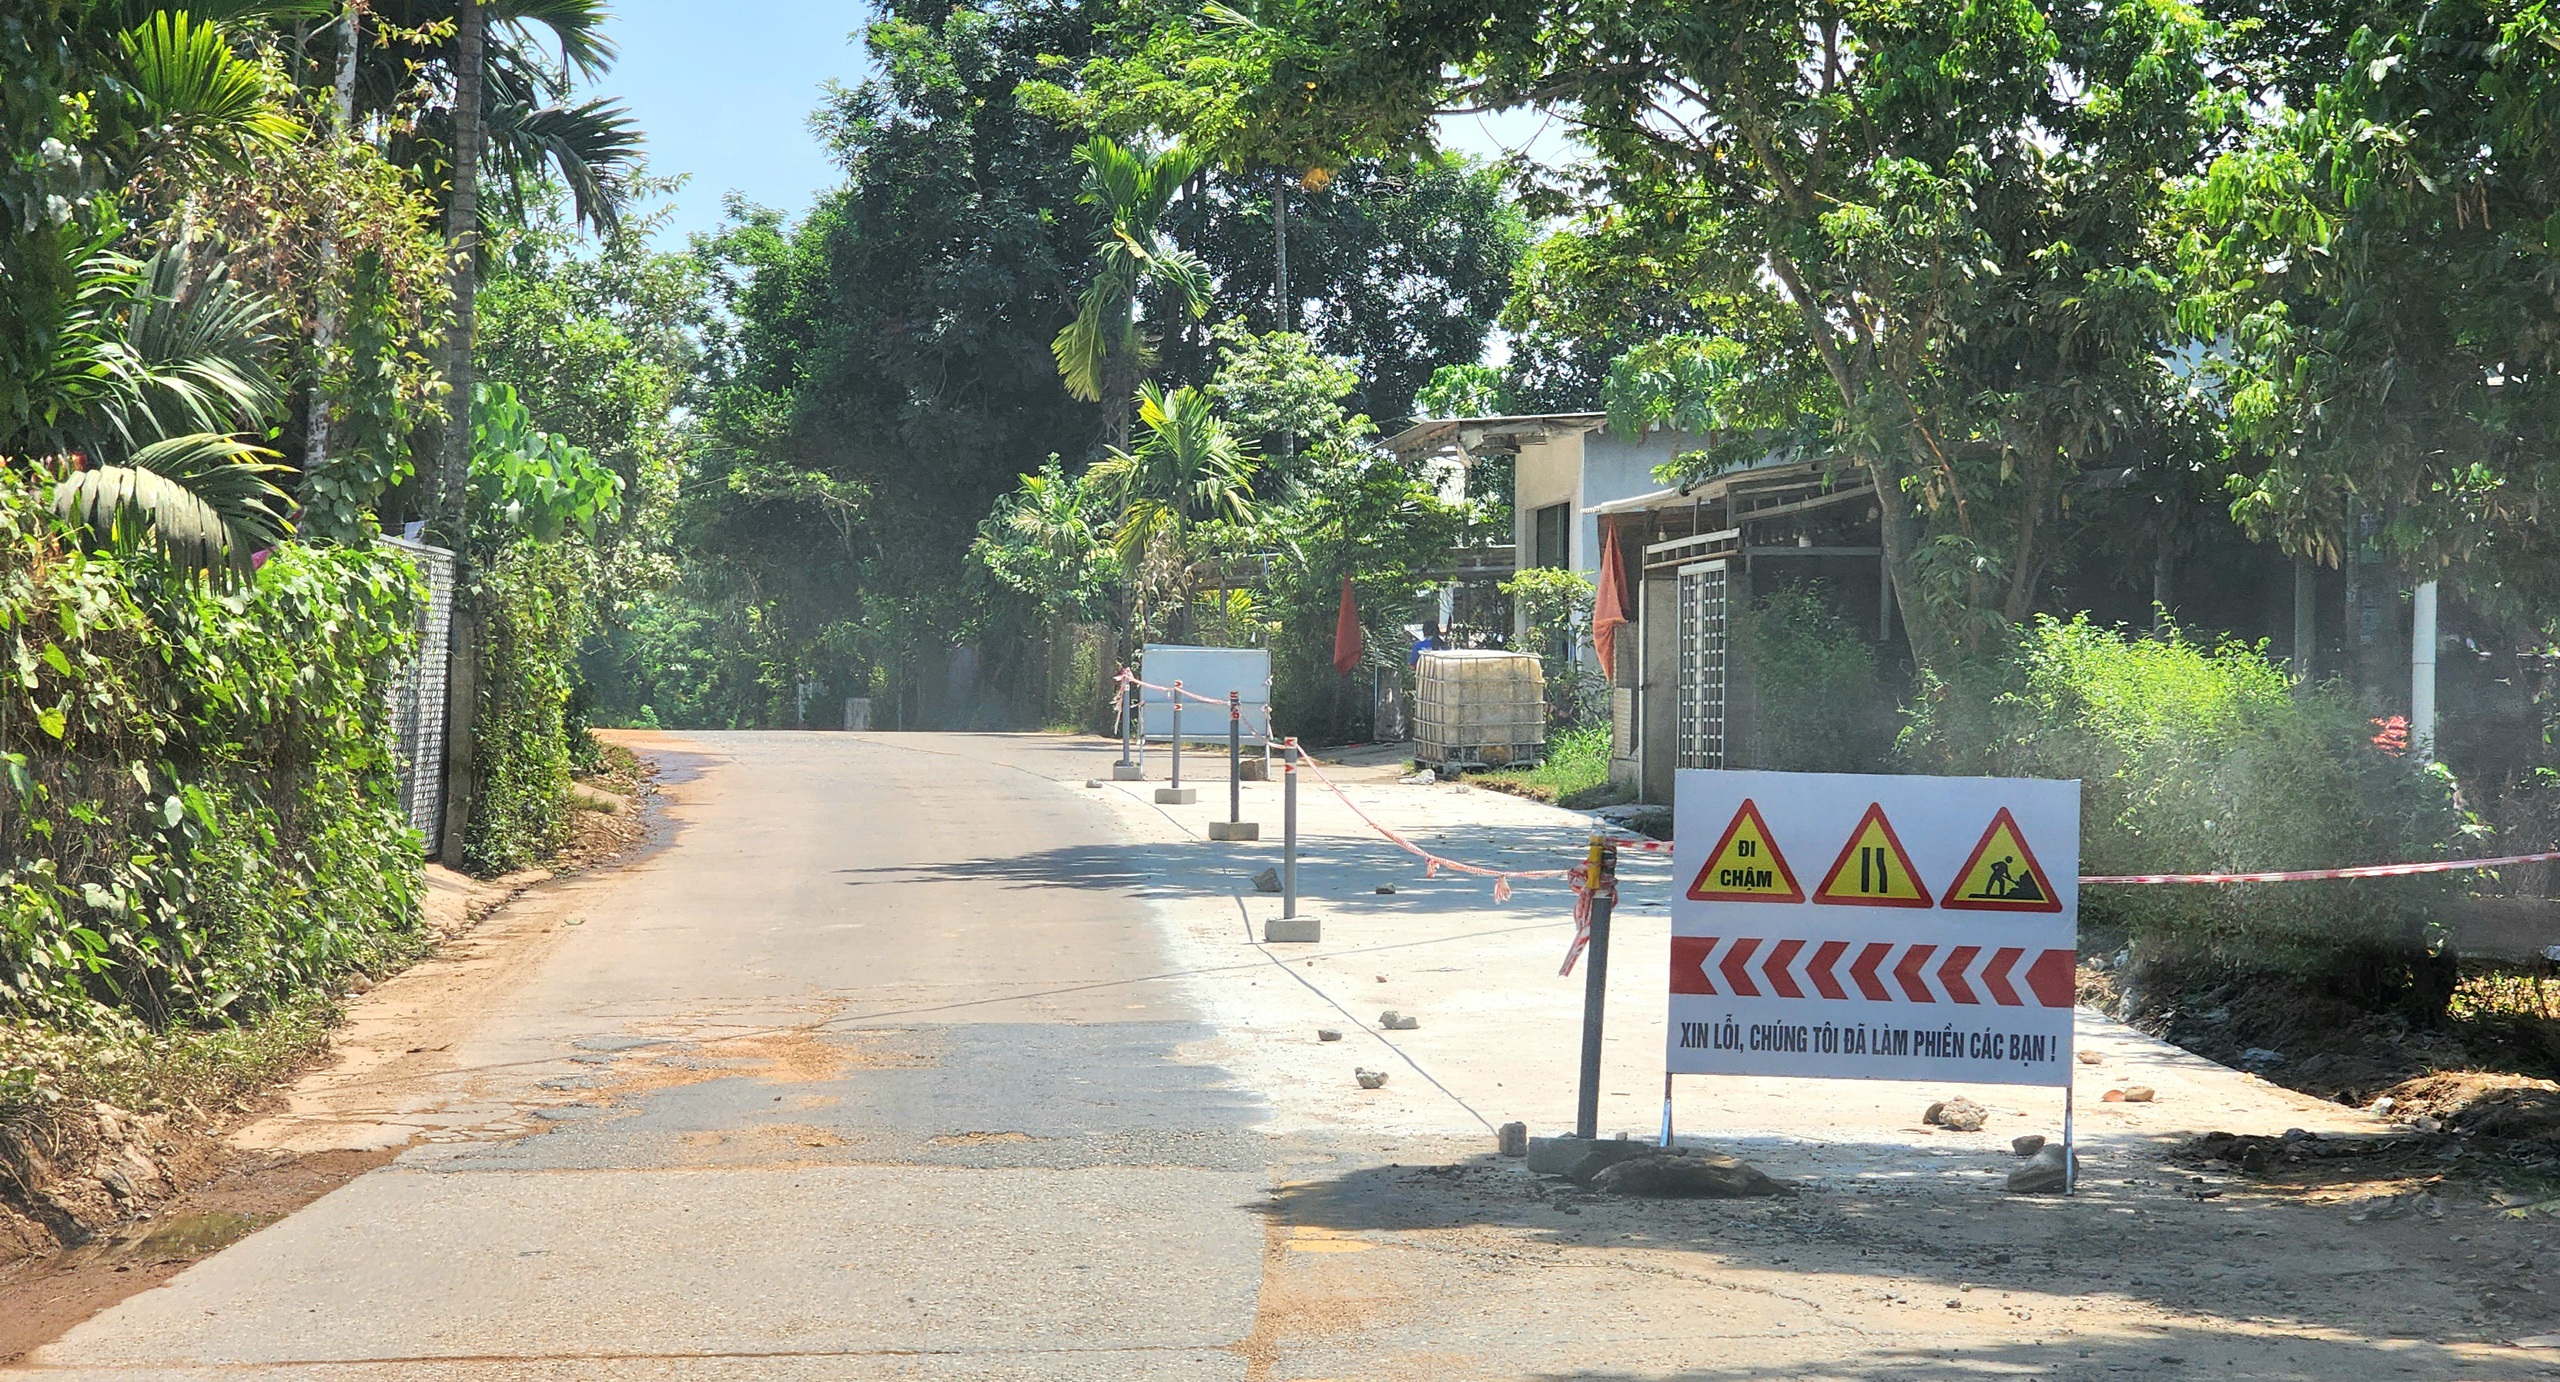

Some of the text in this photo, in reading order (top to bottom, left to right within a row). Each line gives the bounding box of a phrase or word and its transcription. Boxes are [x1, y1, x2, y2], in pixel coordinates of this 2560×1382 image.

[1738, 840, 1756, 857] ĐI
[1720, 866, 1773, 891] CHẬM
[1680, 1022, 1709, 1049] XIN
[1714, 1013, 1744, 1054] LỖI,
[1750, 1020, 1808, 1053] CHÚNG
[1813, 1021, 1838, 1054] TÔI
[1843, 1023, 1867, 1055] ĐÃ
[1871, 1023, 1908, 1056] LÀM
[1914, 1022, 1965, 1059] PHIỀN
[1970, 1027, 2005, 1060] CÁC
[2009, 1034, 2046, 1067] BẠN
